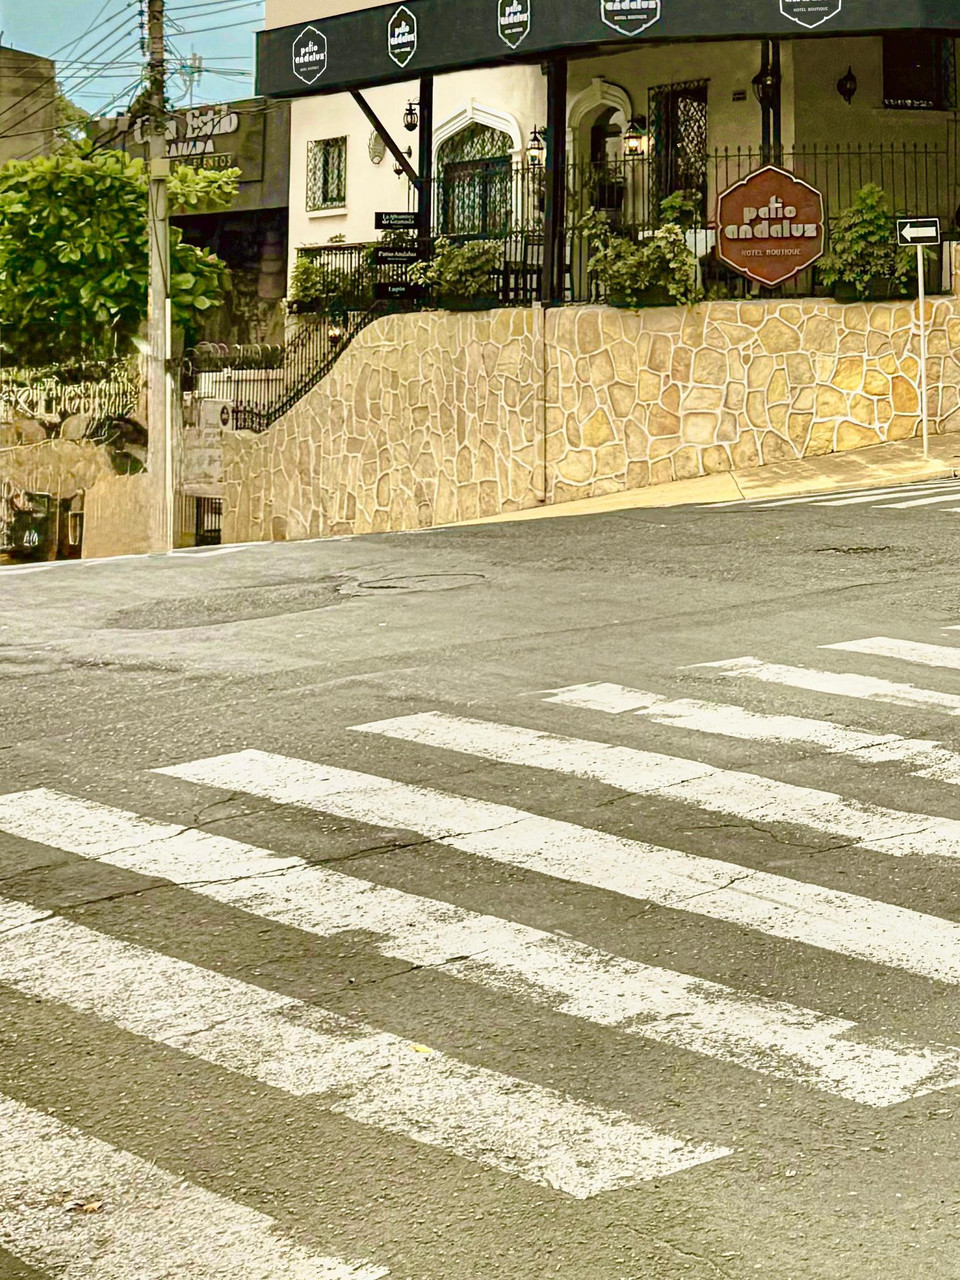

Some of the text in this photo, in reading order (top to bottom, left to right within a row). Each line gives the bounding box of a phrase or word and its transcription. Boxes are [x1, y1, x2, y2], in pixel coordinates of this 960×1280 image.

[301, 40, 318, 56] patio
[295, 52, 324, 63] andaluz
[743, 195, 797, 224] patio
[724, 220, 817, 239] andaluz
